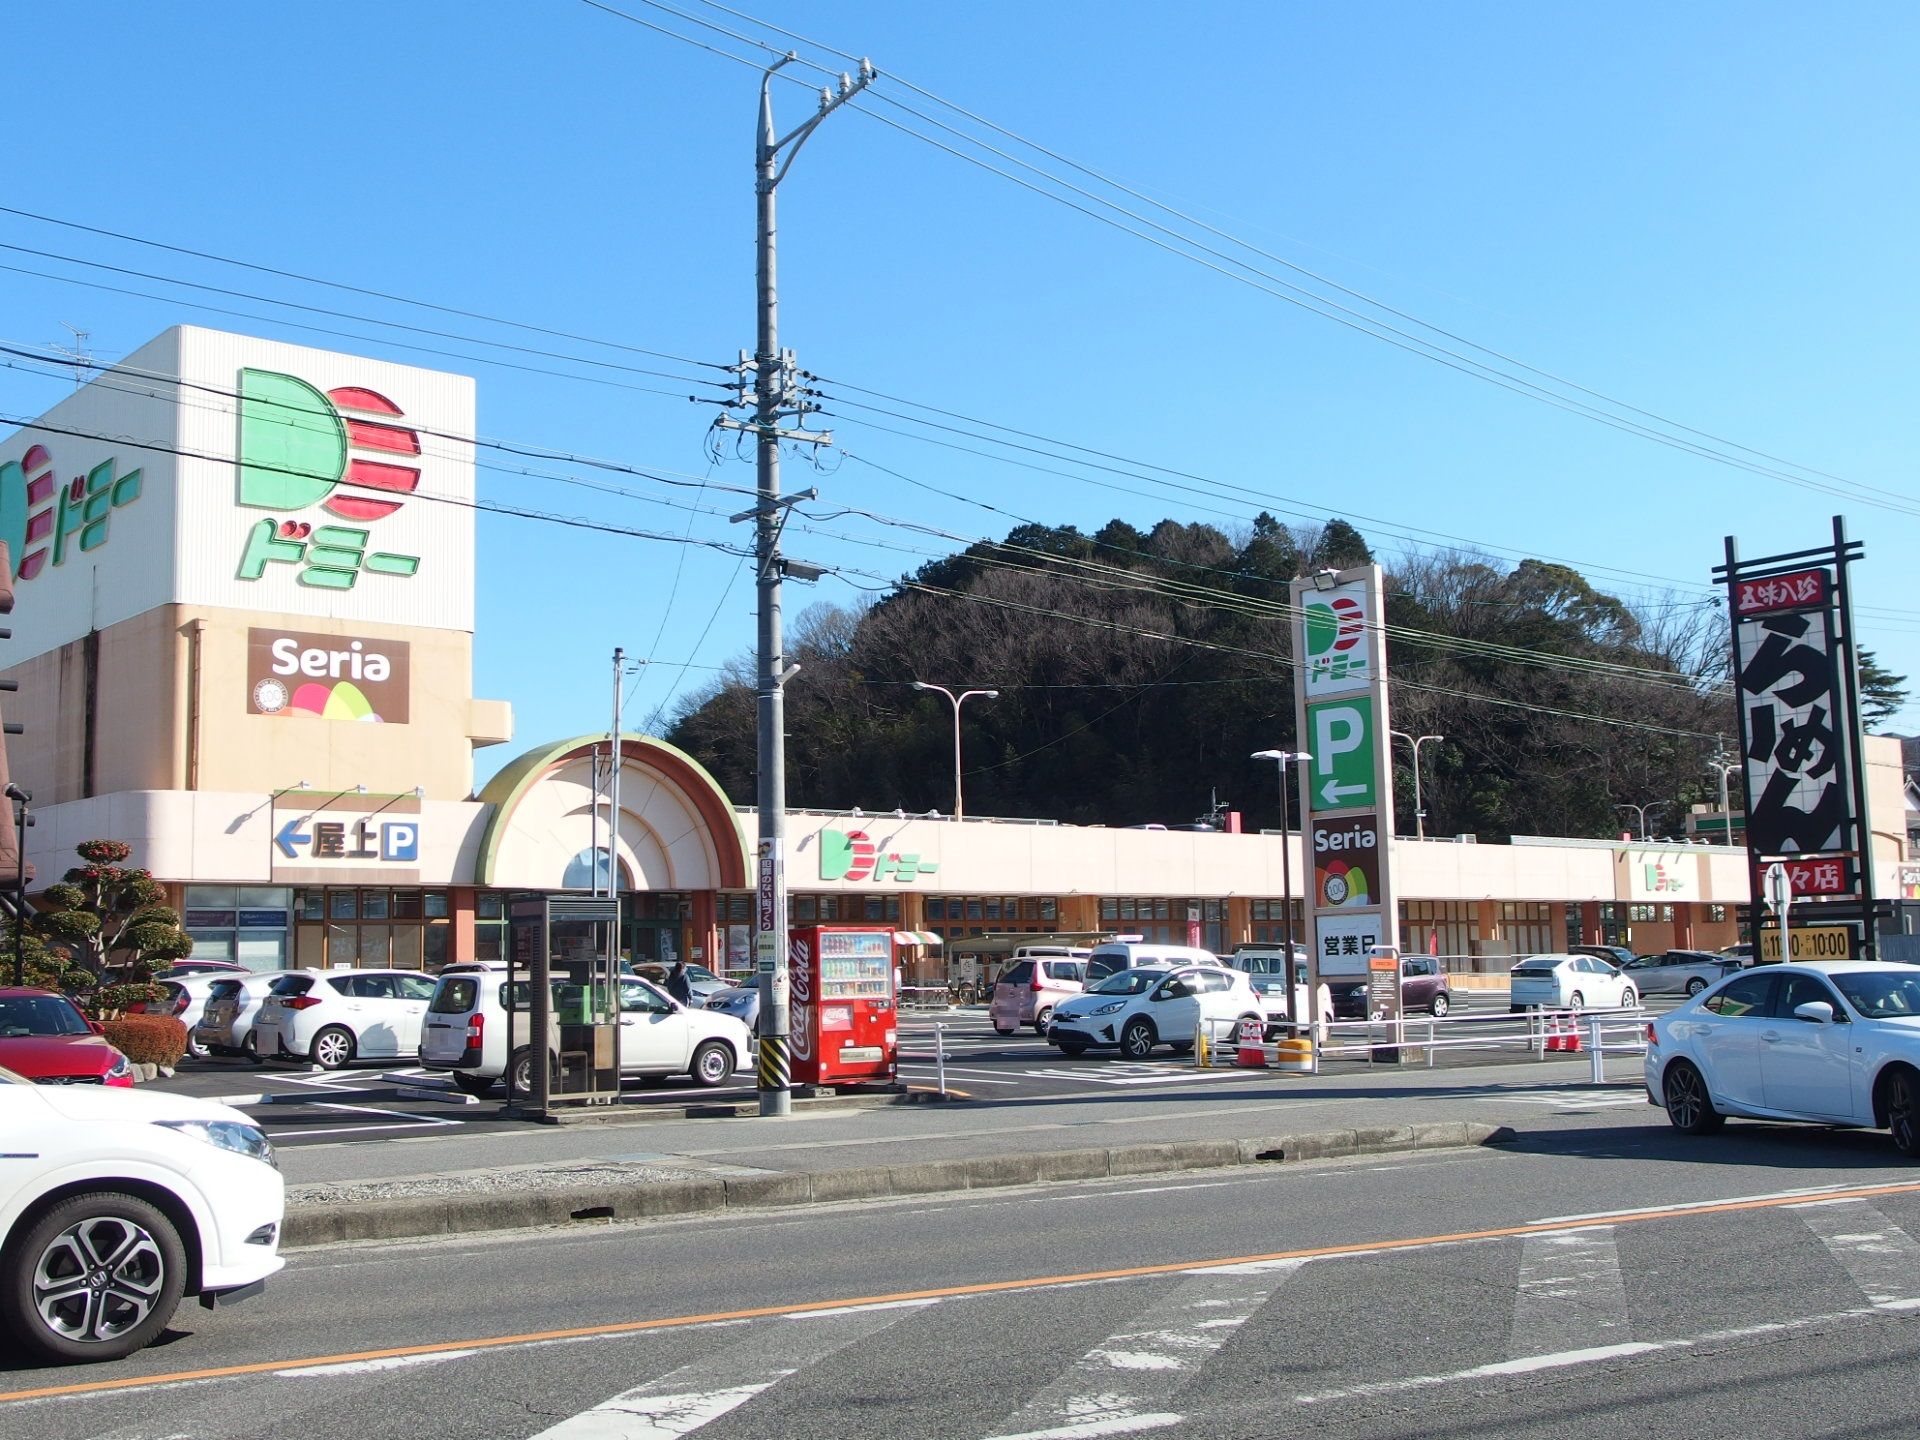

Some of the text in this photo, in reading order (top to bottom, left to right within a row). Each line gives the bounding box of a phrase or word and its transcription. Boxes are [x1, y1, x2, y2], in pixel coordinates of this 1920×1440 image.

[52, 456, 145, 567] ドミー
[235, 517, 421, 591] ドミー
[271, 638, 391, 682] Seria
[1311, 653, 1367, 684] ドミー
[1315, 706, 1365, 776] P
[312, 822, 379, 858] 屋上
[1314, 823, 1377, 852] Seria
[873, 853, 940, 882] ドミー
[1324, 934, 1377, 957] 営業日
[1812, 932, 1846, 956] 10:00
